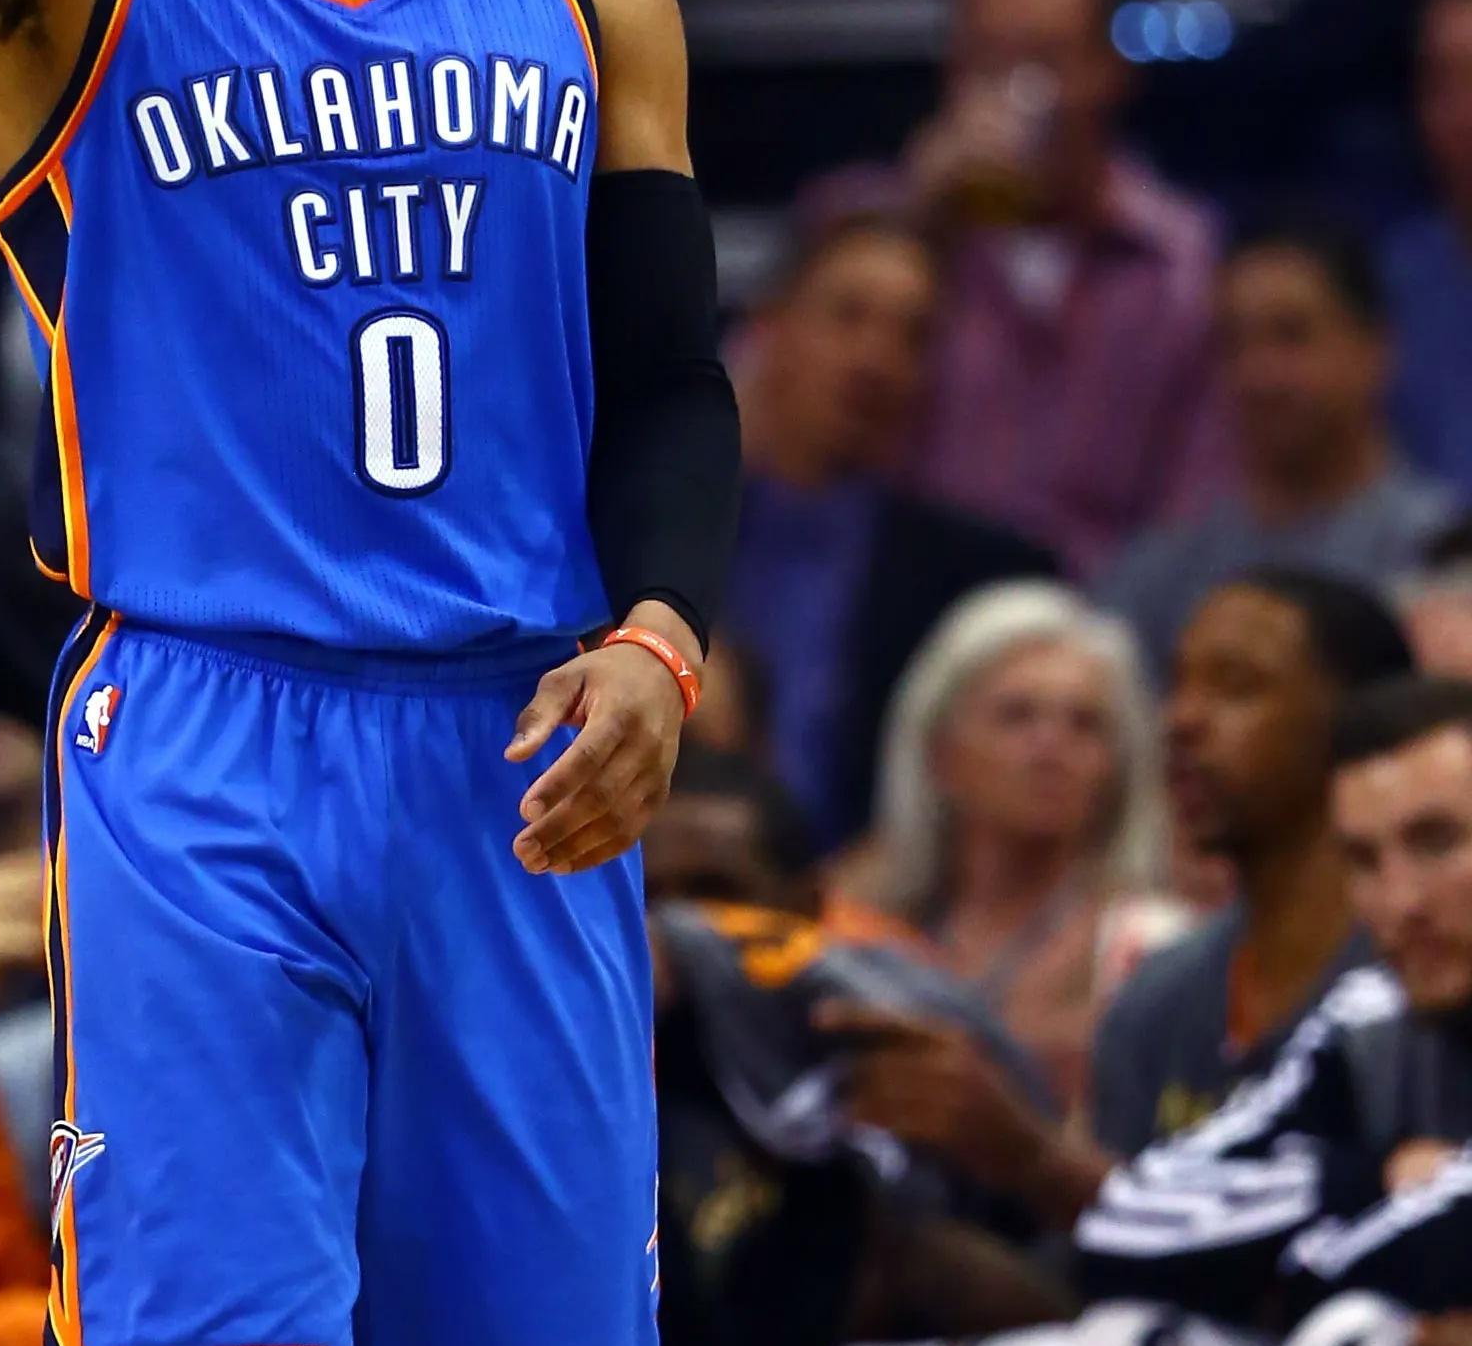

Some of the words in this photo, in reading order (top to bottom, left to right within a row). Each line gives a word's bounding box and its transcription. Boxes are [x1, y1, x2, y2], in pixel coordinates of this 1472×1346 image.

[128, 53, 596, 188] OKLAHOMA
[286, 177, 483, 288] CITY
[351, 306, 450, 497] 0
